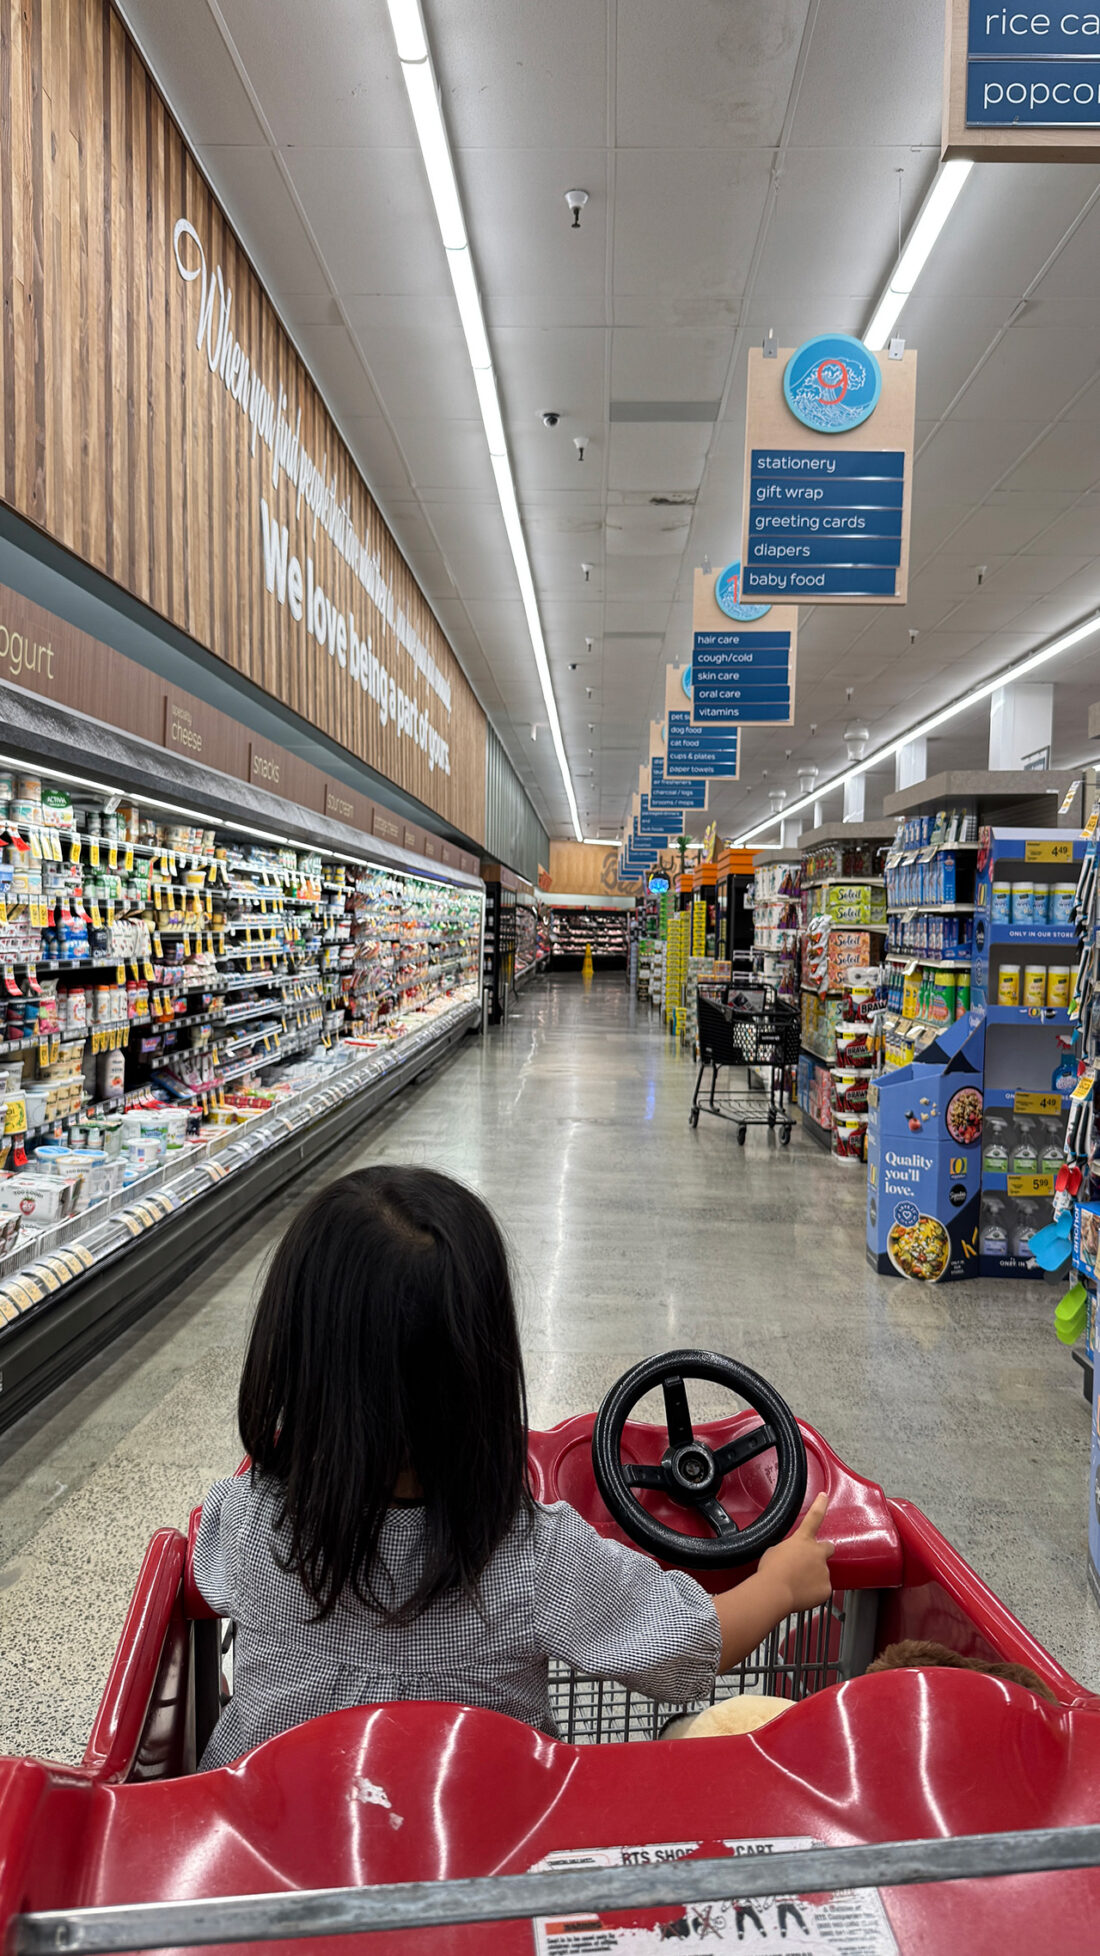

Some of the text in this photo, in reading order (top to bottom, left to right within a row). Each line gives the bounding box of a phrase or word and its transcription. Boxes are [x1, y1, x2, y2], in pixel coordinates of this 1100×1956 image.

[986, 8, 1050, 35] rice
[984, 82, 1100, 110] popco
[817, 359, 848, 405] 9
[250, 369, 274, 458] you
[272, 383, 301, 490] find
[757, 457, 836, 473] stationery
[757, 486, 824, 501] gift wrap
[755, 515, 866, 531] greeting cards
[754, 544, 810, 559] diapers
[750, 573, 825, 589] baby food
[261, 497, 303, 622] We
[307, 557, 347, 668] love
[349, 612, 388, 727] being
[389, 677, 396, 720] a
[397, 685, 418, 744] part
[418, 708, 429, 752] of
[697, 635, 739, 645] hair care
[697, 653, 753, 665] cough/cold
[697, 671, 740, 681] skin care
[699, 689, 741, 699] oral care
[671, 713, 683, 721] pet
[699, 707, 740, 717] vitamins
[171, 720, 202, 753] cheese
[253, 754, 280, 783] snacks
[885, 1151, 933, 1171] Quality
[885, 1169, 920, 1183] you'll
[885, 1181, 915, 1197] love.
[1072, 1204, 1080, 1250] anchor
[621, 1851, 651, 1866] RTS
